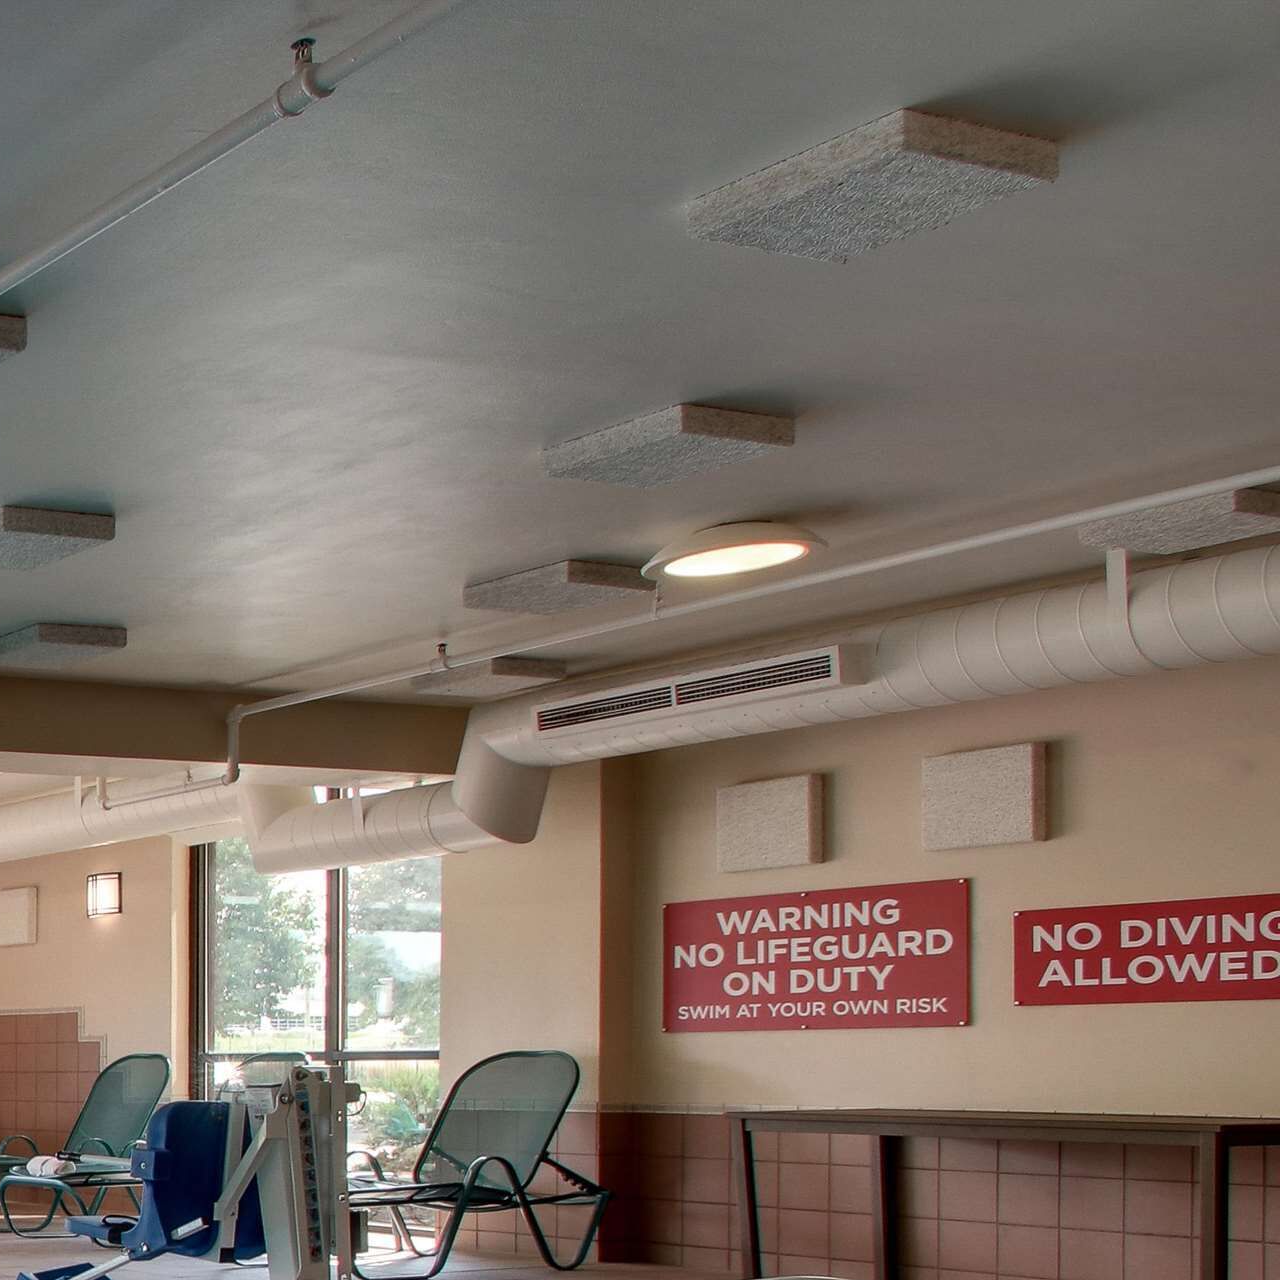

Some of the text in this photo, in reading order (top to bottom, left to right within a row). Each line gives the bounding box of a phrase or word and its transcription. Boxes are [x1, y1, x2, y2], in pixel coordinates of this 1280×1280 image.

[716, 898, 901, 936] WARNING
[1032, 910, 1280, 953] NO DIVING
[673, 928, 954, 969] NO LIFEGUARD
[722, 964, 895, 997] ON DUTY
[1038, 950, 1280, 988] ALLOWED
[677, 997, 948, 1020] SWIM AT YOUR OWN RISK
